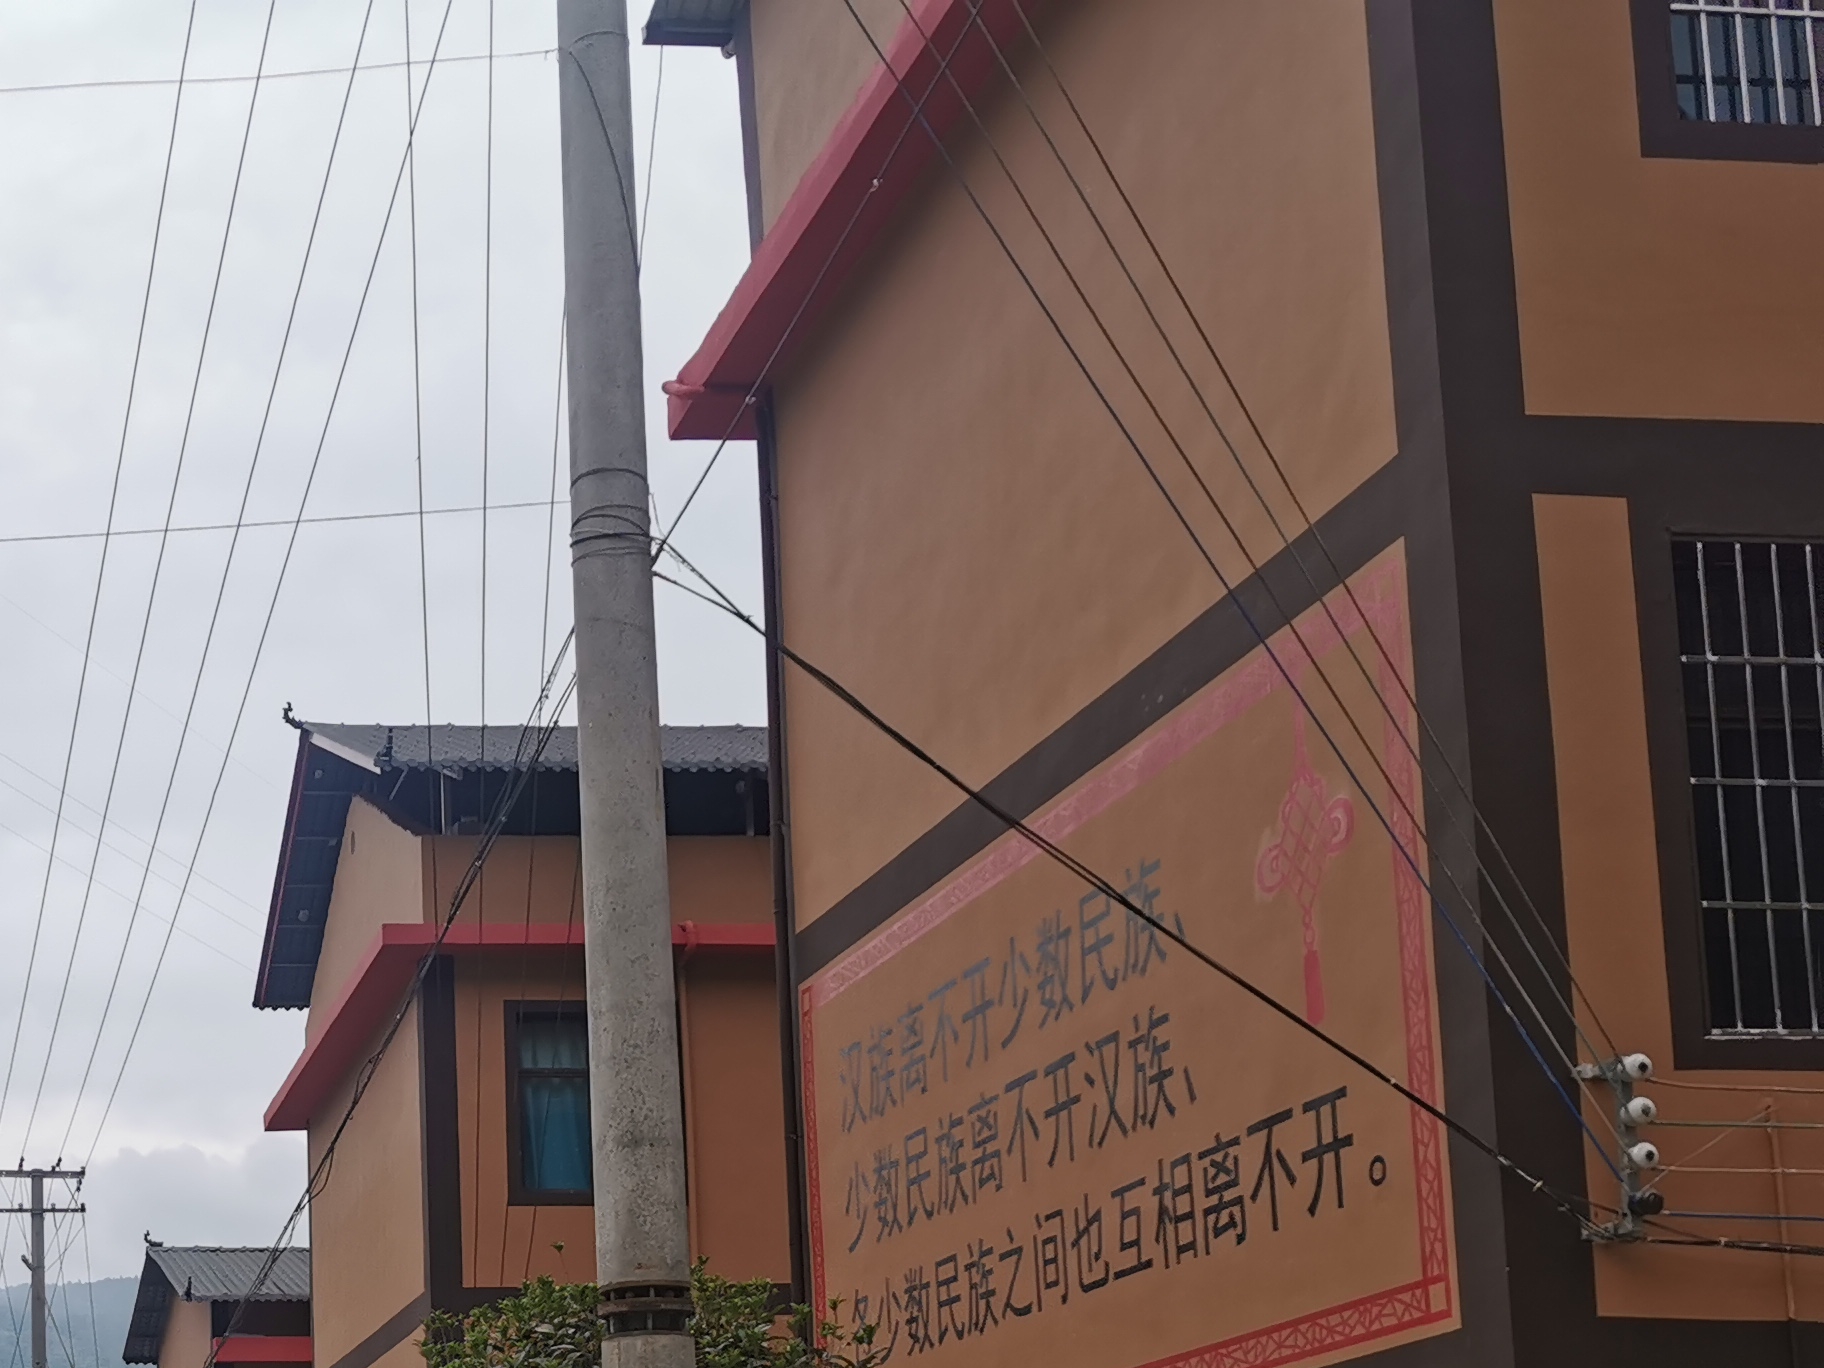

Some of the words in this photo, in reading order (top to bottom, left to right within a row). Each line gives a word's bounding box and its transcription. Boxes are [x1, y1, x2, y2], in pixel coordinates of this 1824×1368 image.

[845, 1005, 1198, 1254] 少数民族离不开汉族、
